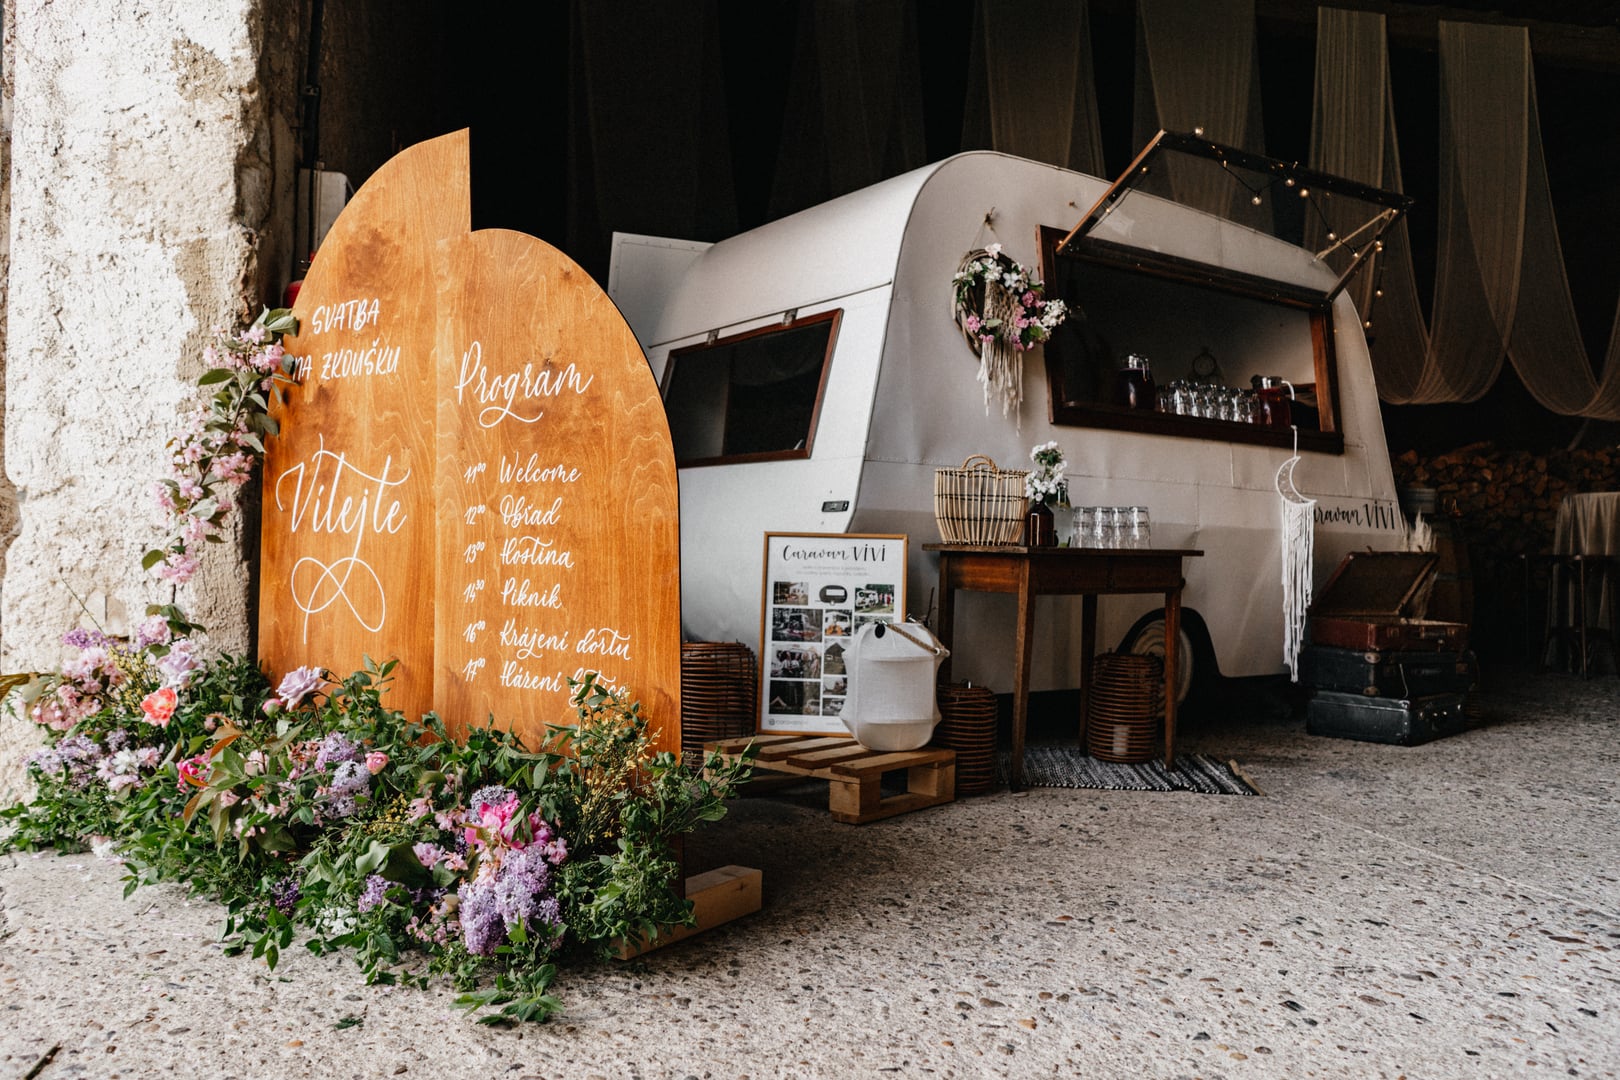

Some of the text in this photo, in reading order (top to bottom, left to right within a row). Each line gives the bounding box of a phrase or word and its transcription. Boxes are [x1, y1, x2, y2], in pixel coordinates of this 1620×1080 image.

[311, 298, 380, 335] SVATBA
[320, 337, 401, 380] ZKOUŠKU
[453, 340, 594, 428] Program
[499, 450, 582, 483] Welcome
[499, 494, 563, 528] Obřad
[499, 535, 575, 568] Hostina
[783, 545, 849, 561] Caravan
[500, 576, 563, 609] Piknik
[499, 618, 569, 660] Krájení
[576, 627, 632, 661] dortu
[499, 660, 562, 693] Házení
